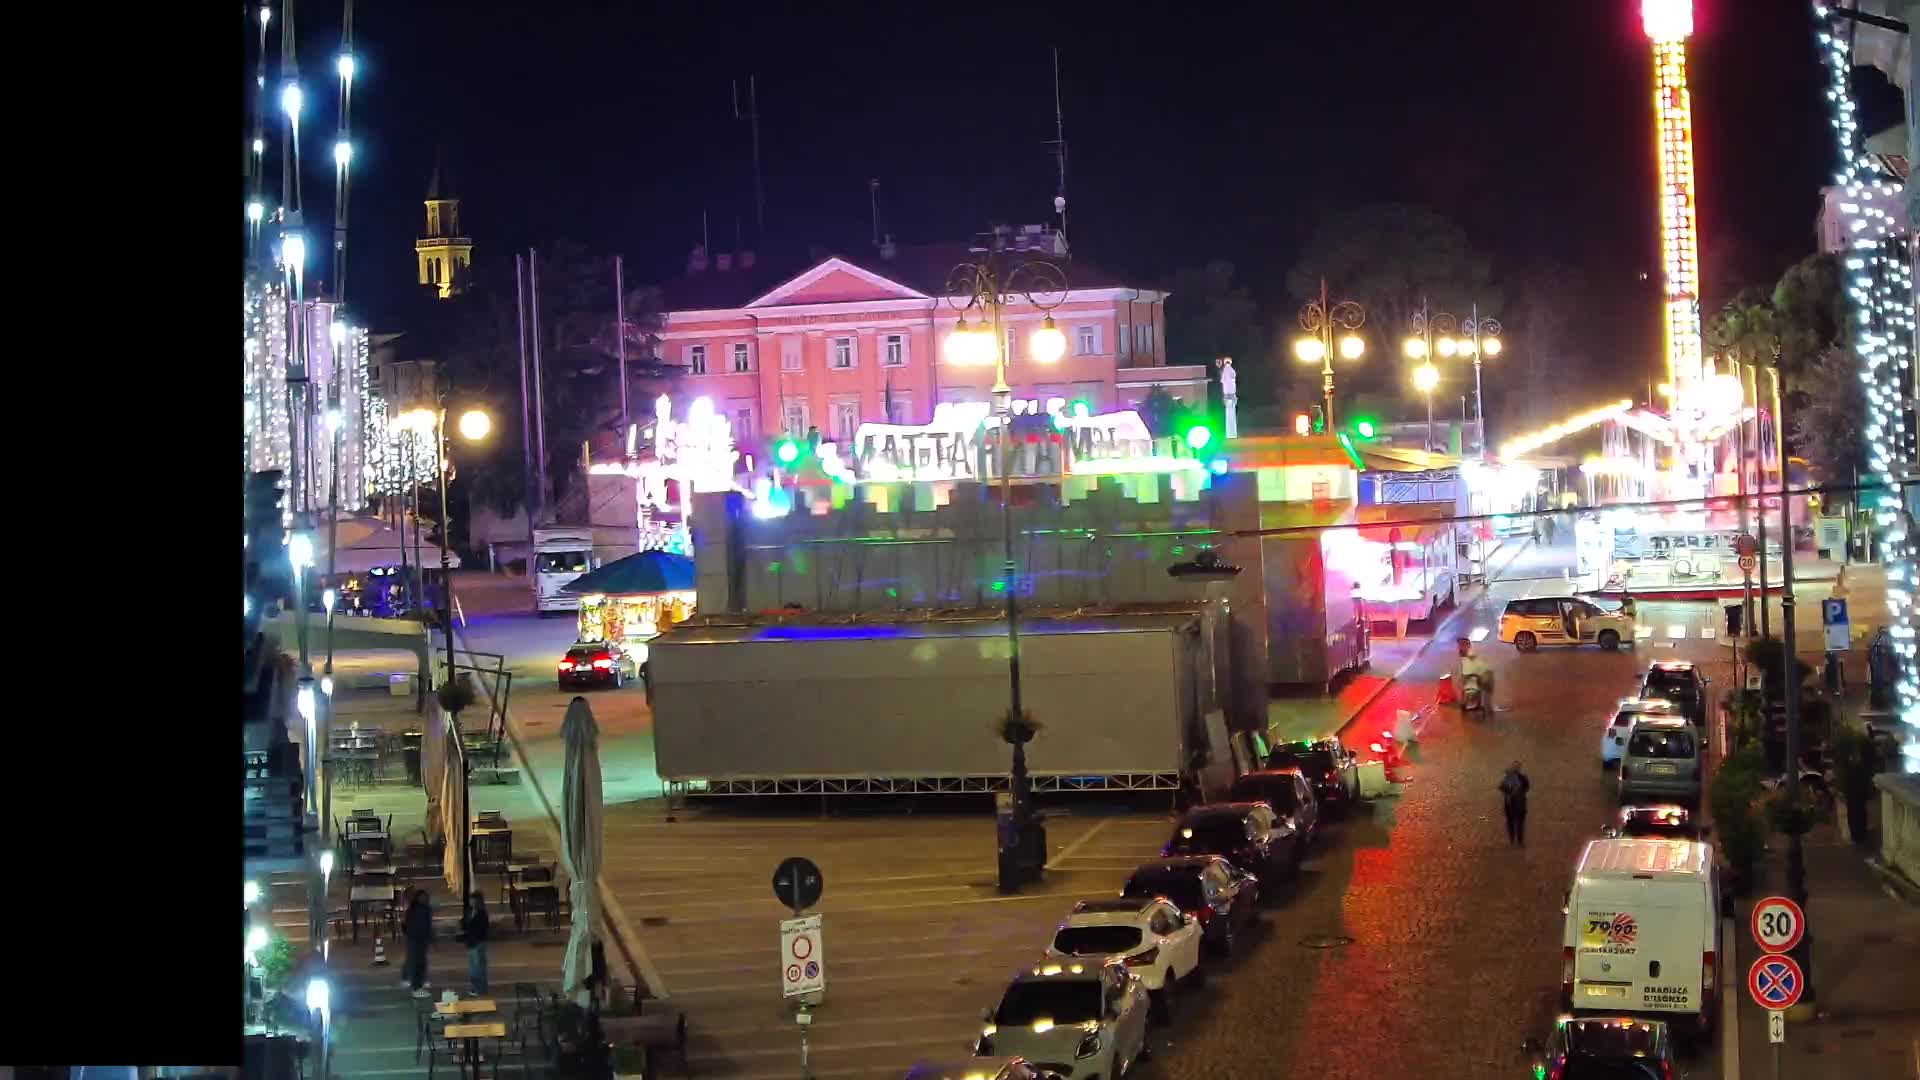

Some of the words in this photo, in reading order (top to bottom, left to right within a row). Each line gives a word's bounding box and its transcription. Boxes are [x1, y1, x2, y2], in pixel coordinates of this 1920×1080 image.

[1742, 558, 1753, 567] 20
[1827, 602, 1842, 623] P
[1762, 911, 1792, 938] 30
